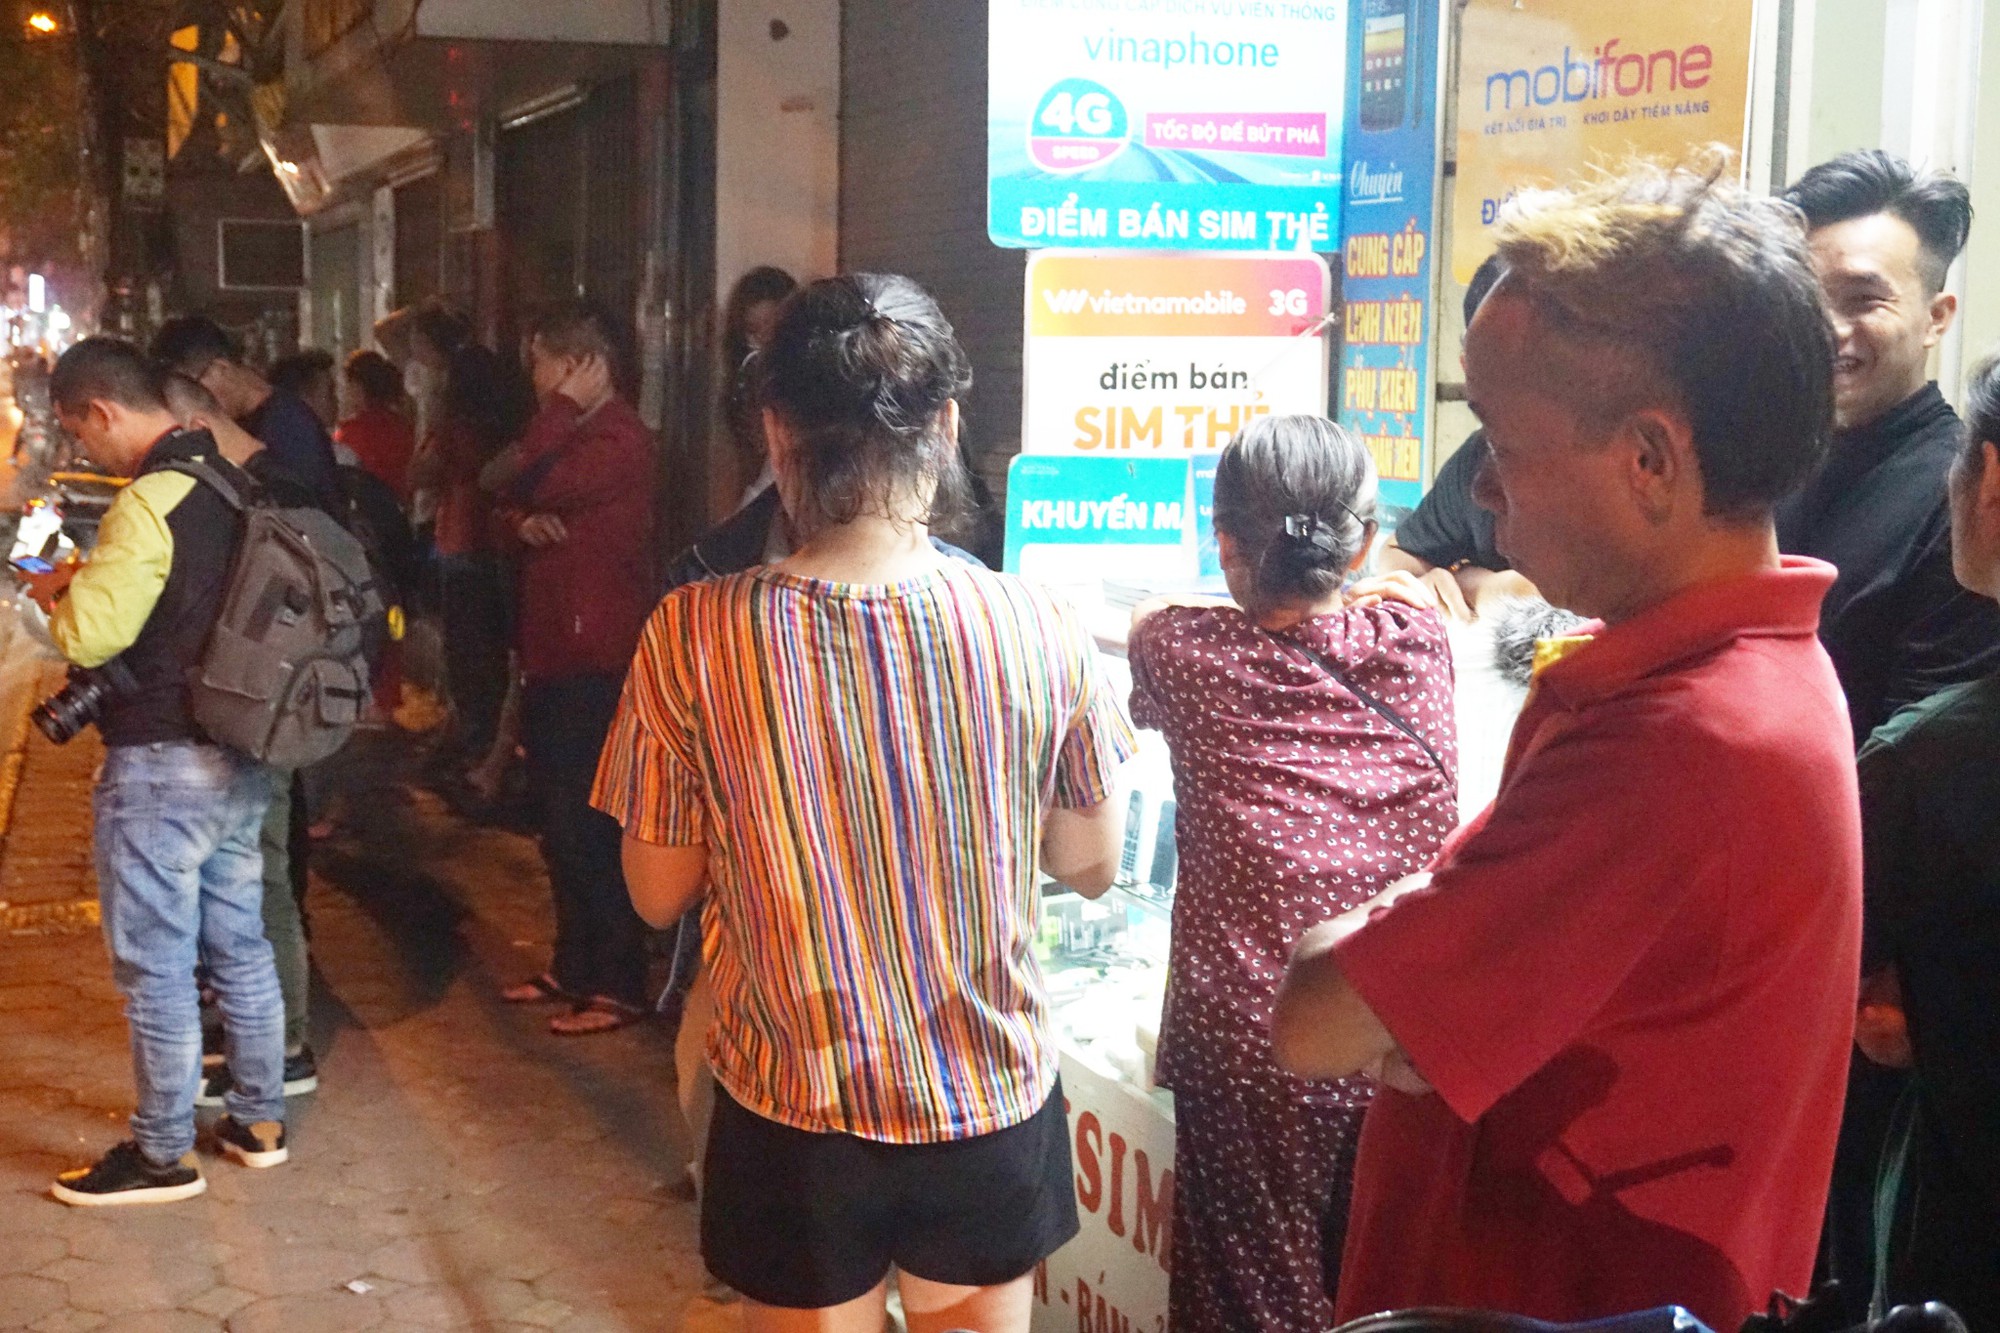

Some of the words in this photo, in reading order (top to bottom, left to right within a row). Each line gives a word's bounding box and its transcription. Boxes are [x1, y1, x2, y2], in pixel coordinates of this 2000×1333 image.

[1280, 3, 1336, 21] THÔNG
[1083, 28, 1279, 69] vinaphone
[1485, 38, 1713, 111] mobifone
[1041, 91, 1112, 134] 4G
[1152, 118, 1188, 141] TỐC
[1286, 124, 1320, 144] PHÁ
[1020, 192, 1108, 238] ĐIỂM
[1118, 201, 1190, 240] BÁN
[1199, 209, 1258, 241] SIM
[1265, 201, 1330, 241] THẺ
[1346, 233, 1389, 278] CUNG
[1392, 215, 1426, 276] CẤP
[1089, 289, 1247, 315] vietnamobile
[1268, 288, 1308, 316] 3G
[1383, 290, 1422, 354] KIỆN
[1100, 360, 1178, 390] điểm
[1190, 362, 1248, 390] bán
[1344, 367, 1377, 420] PHỤ
[1379, 360, 1418, 421] KIỆN
[1073, 406, 1163, 450] SIM
[1021, 492, 1148, 530] KHUYẾN
[1153, 502, 1184, 530] M
[1076, 1111, 1174, 1273] SIM
